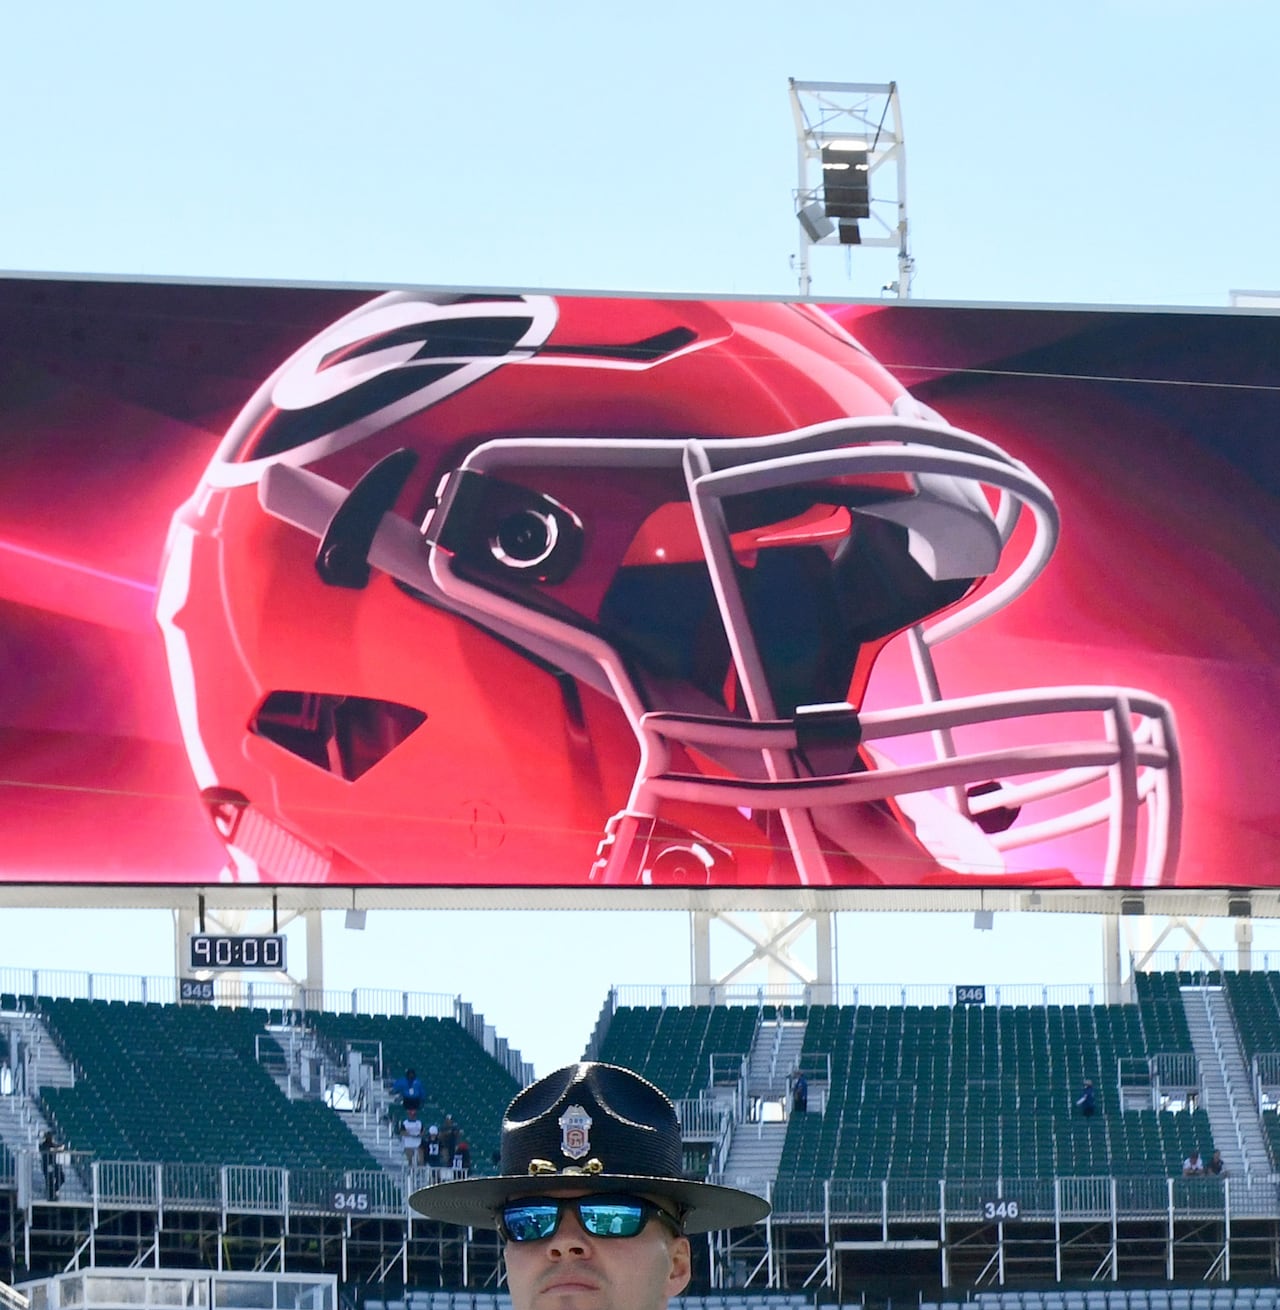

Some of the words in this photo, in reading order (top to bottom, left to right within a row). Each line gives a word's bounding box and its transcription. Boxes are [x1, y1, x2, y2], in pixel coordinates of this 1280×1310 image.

[194, 938, 280, 965] 90:00
[182, 982, 212, 998] 345
[958, 988, 983, 1002] 346
[334, 1193, 369, 1211] 345
[985, 1201, 1019, 1219] 346
